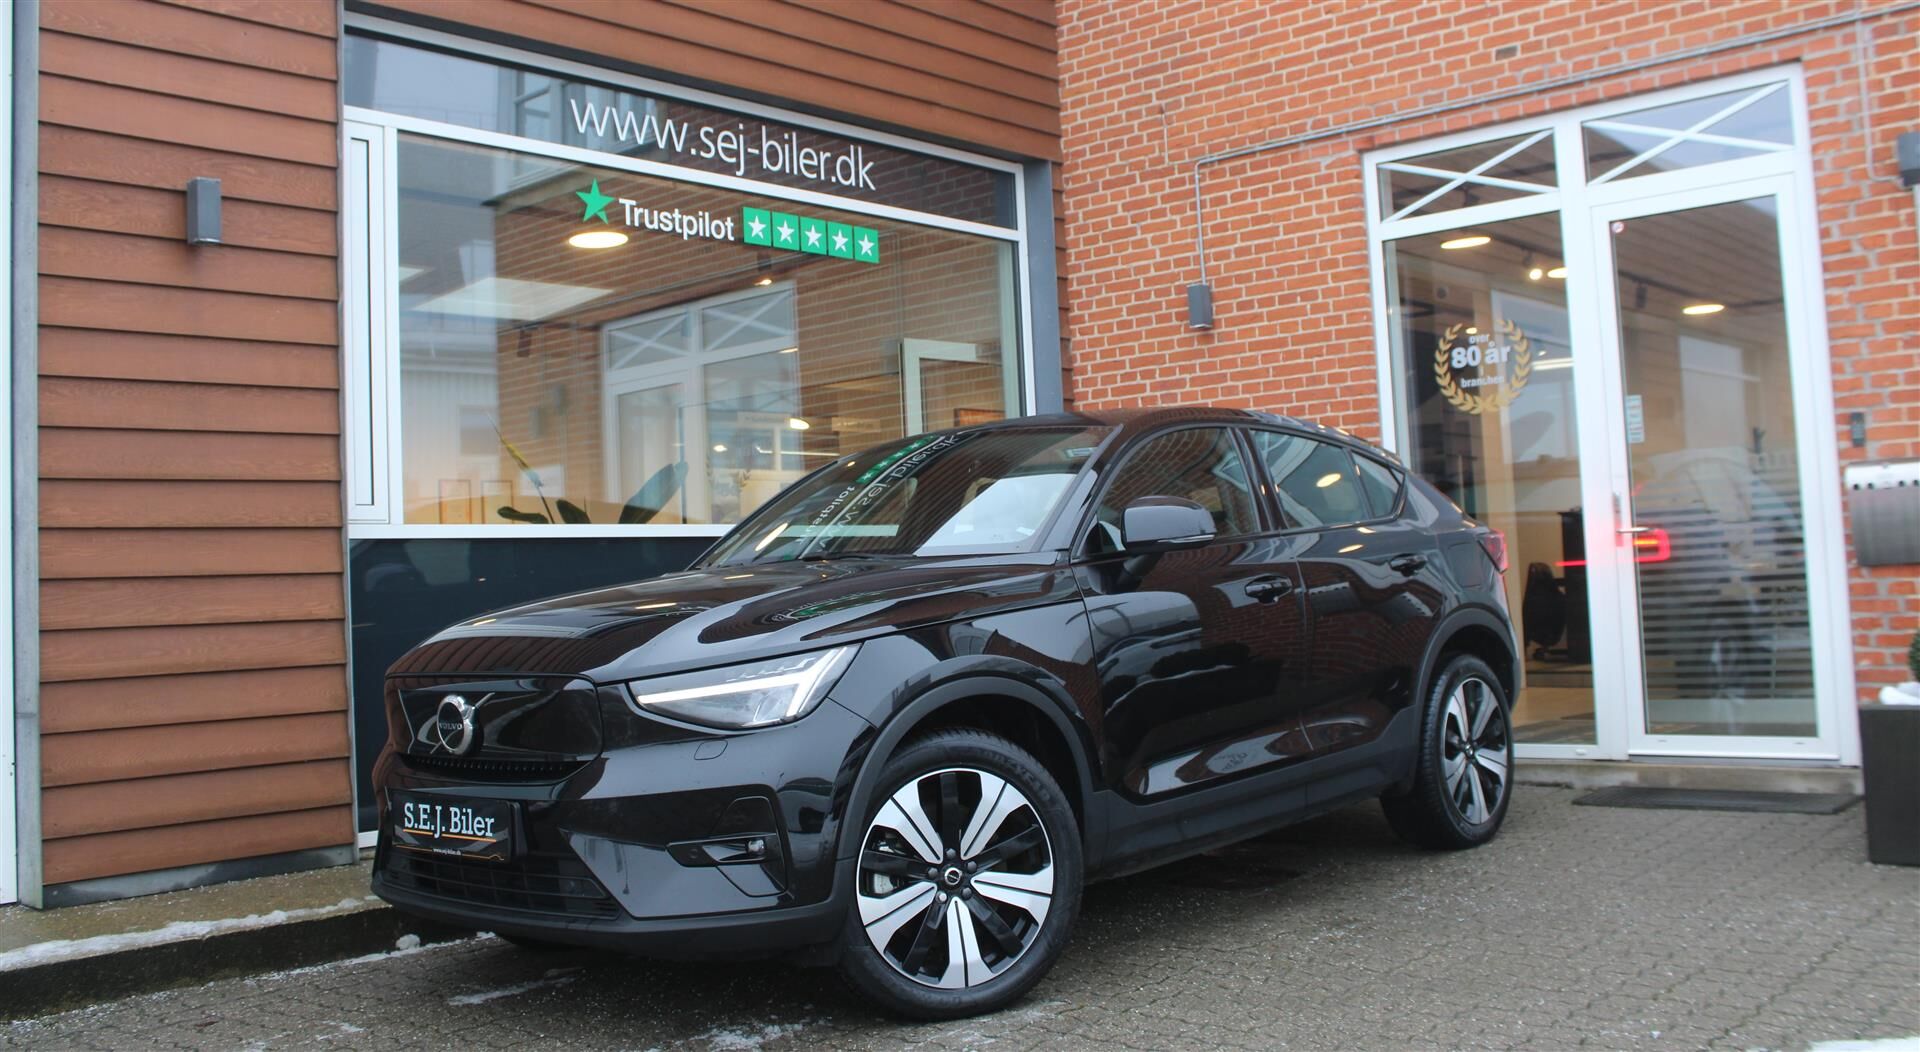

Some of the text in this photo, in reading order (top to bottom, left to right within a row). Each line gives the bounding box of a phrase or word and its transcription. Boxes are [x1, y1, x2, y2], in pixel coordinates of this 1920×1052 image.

[571, 98, 876, 190] www.sej-biler.dk
[619, 198, 735, 241] Trustpilot
[1451, 341, 1511, 368] 80 år
[439, 722, 463, 730] VOLVO
[404, 802, 494, 838] S.E.J. Biler
